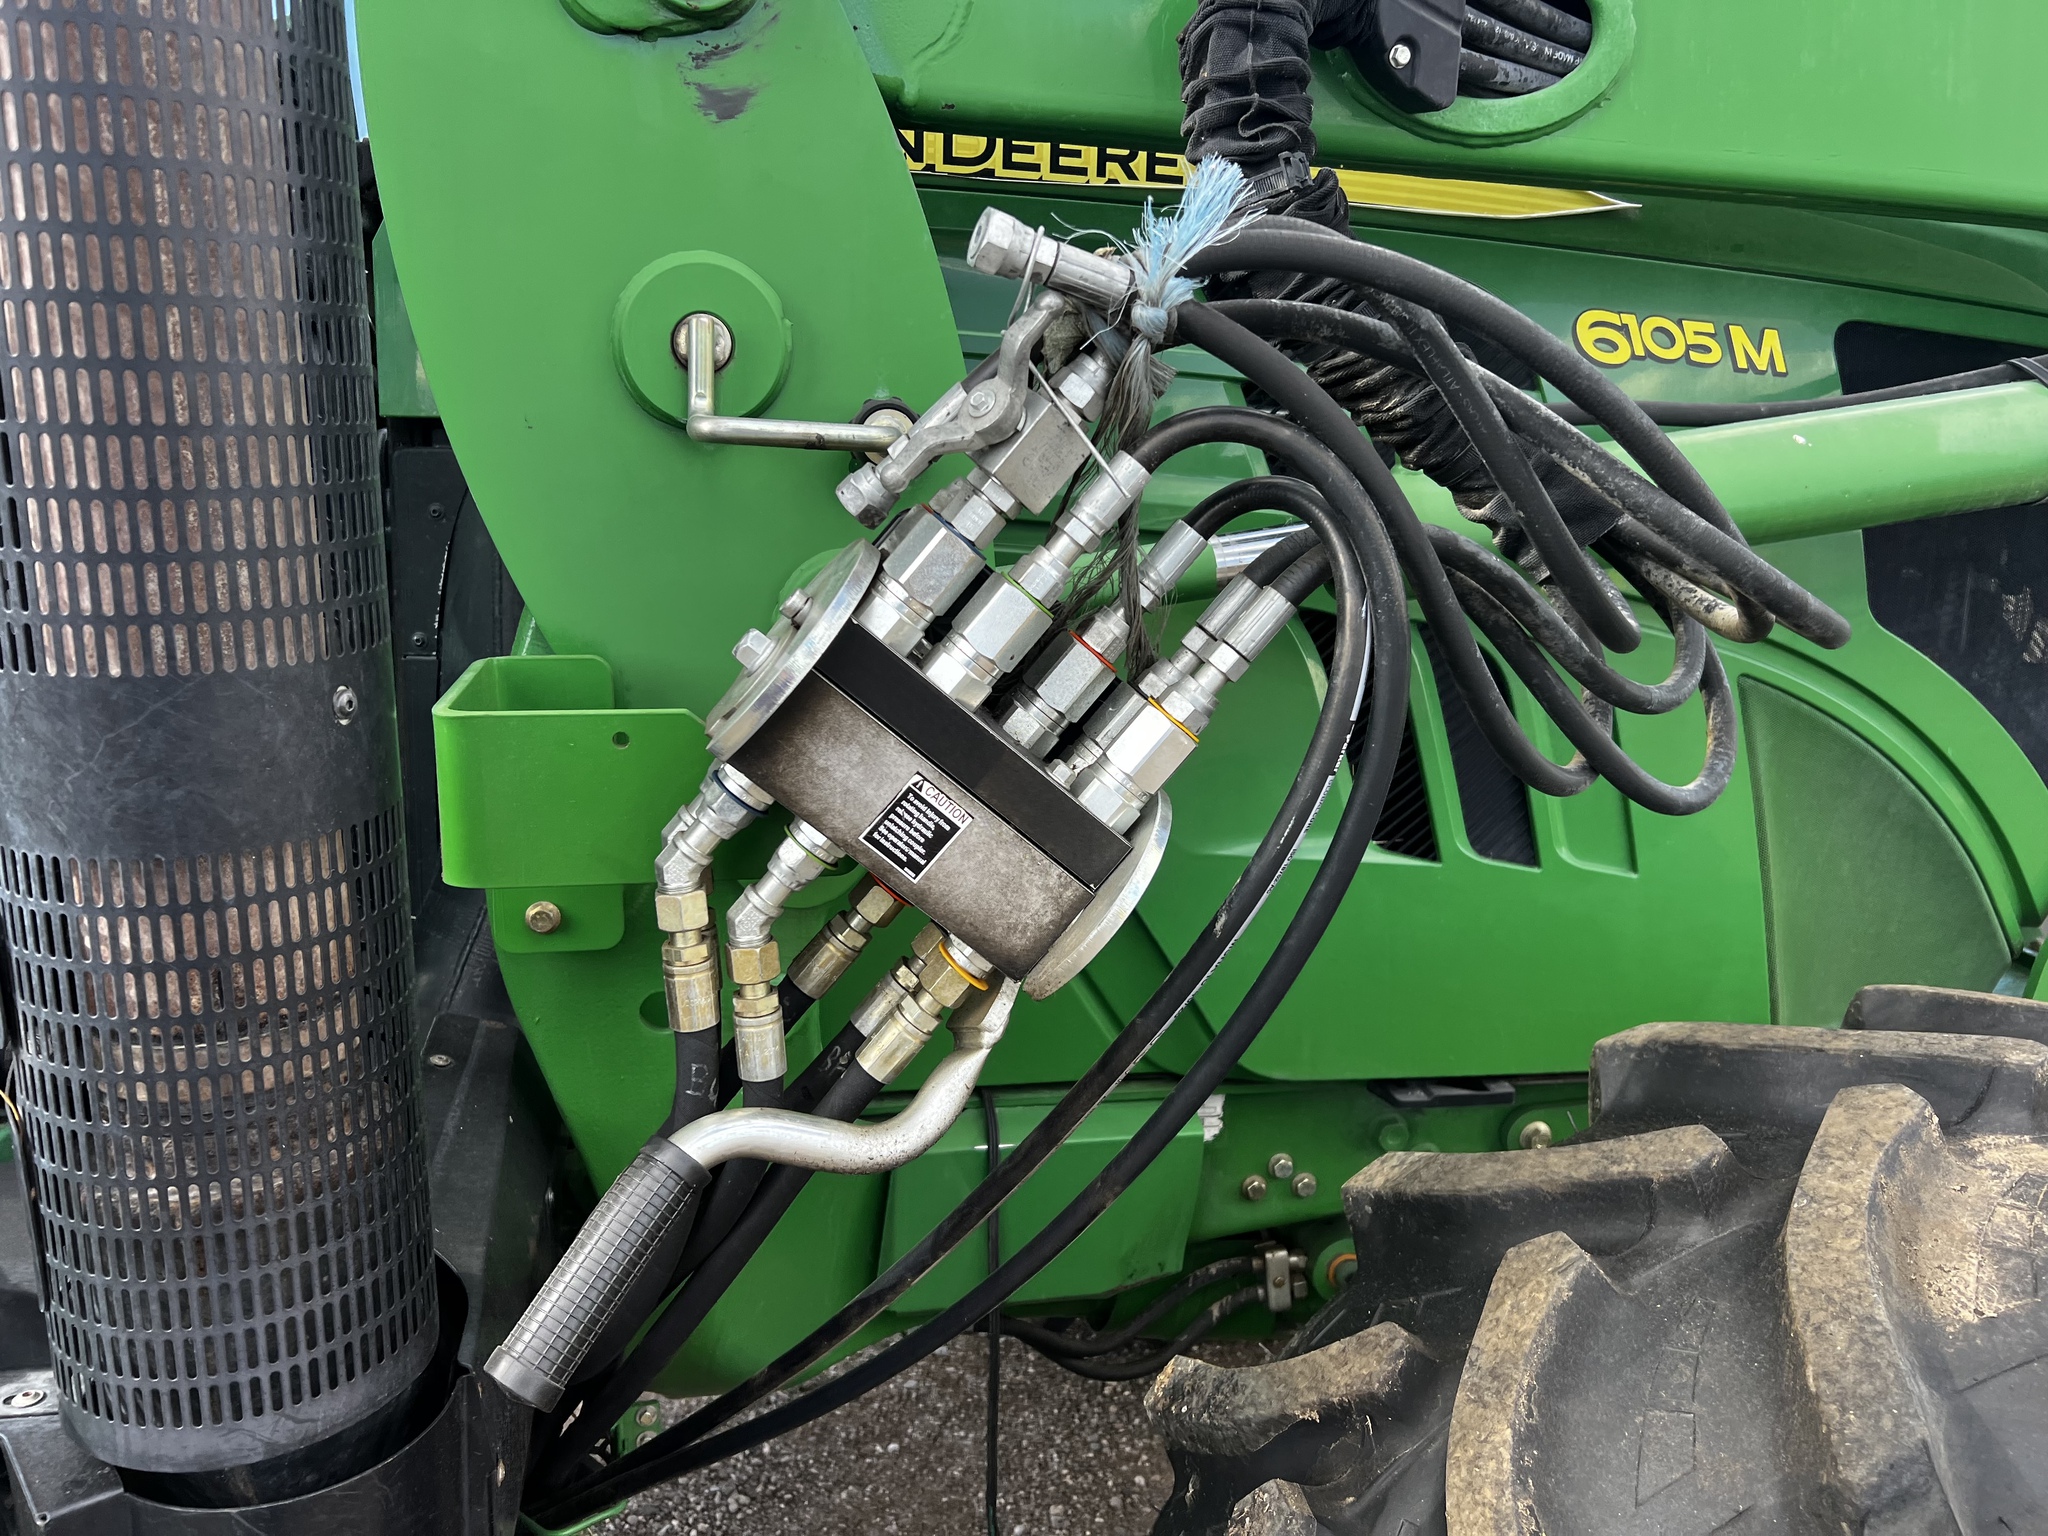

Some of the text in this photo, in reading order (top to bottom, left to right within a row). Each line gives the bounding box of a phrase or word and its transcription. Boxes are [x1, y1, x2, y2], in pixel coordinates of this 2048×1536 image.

[942, 133, 1184, 185] DEERE
[1572, 308, 1788, 377] 6105 M
[900, 800, 920, 817] rotating
[907, 793, 951, 831] To avoid injury from
[924, 786, 969, 824] CAUTION
[873, 832, 881, 840] for
[884, 820, 908, 841] unlatching
[889, 813, 925, 842] pressure before
[911, 819, 933, 838] hydraulic
[878, 826, 888, 835] See
[908, 850, 926, 865] manual
